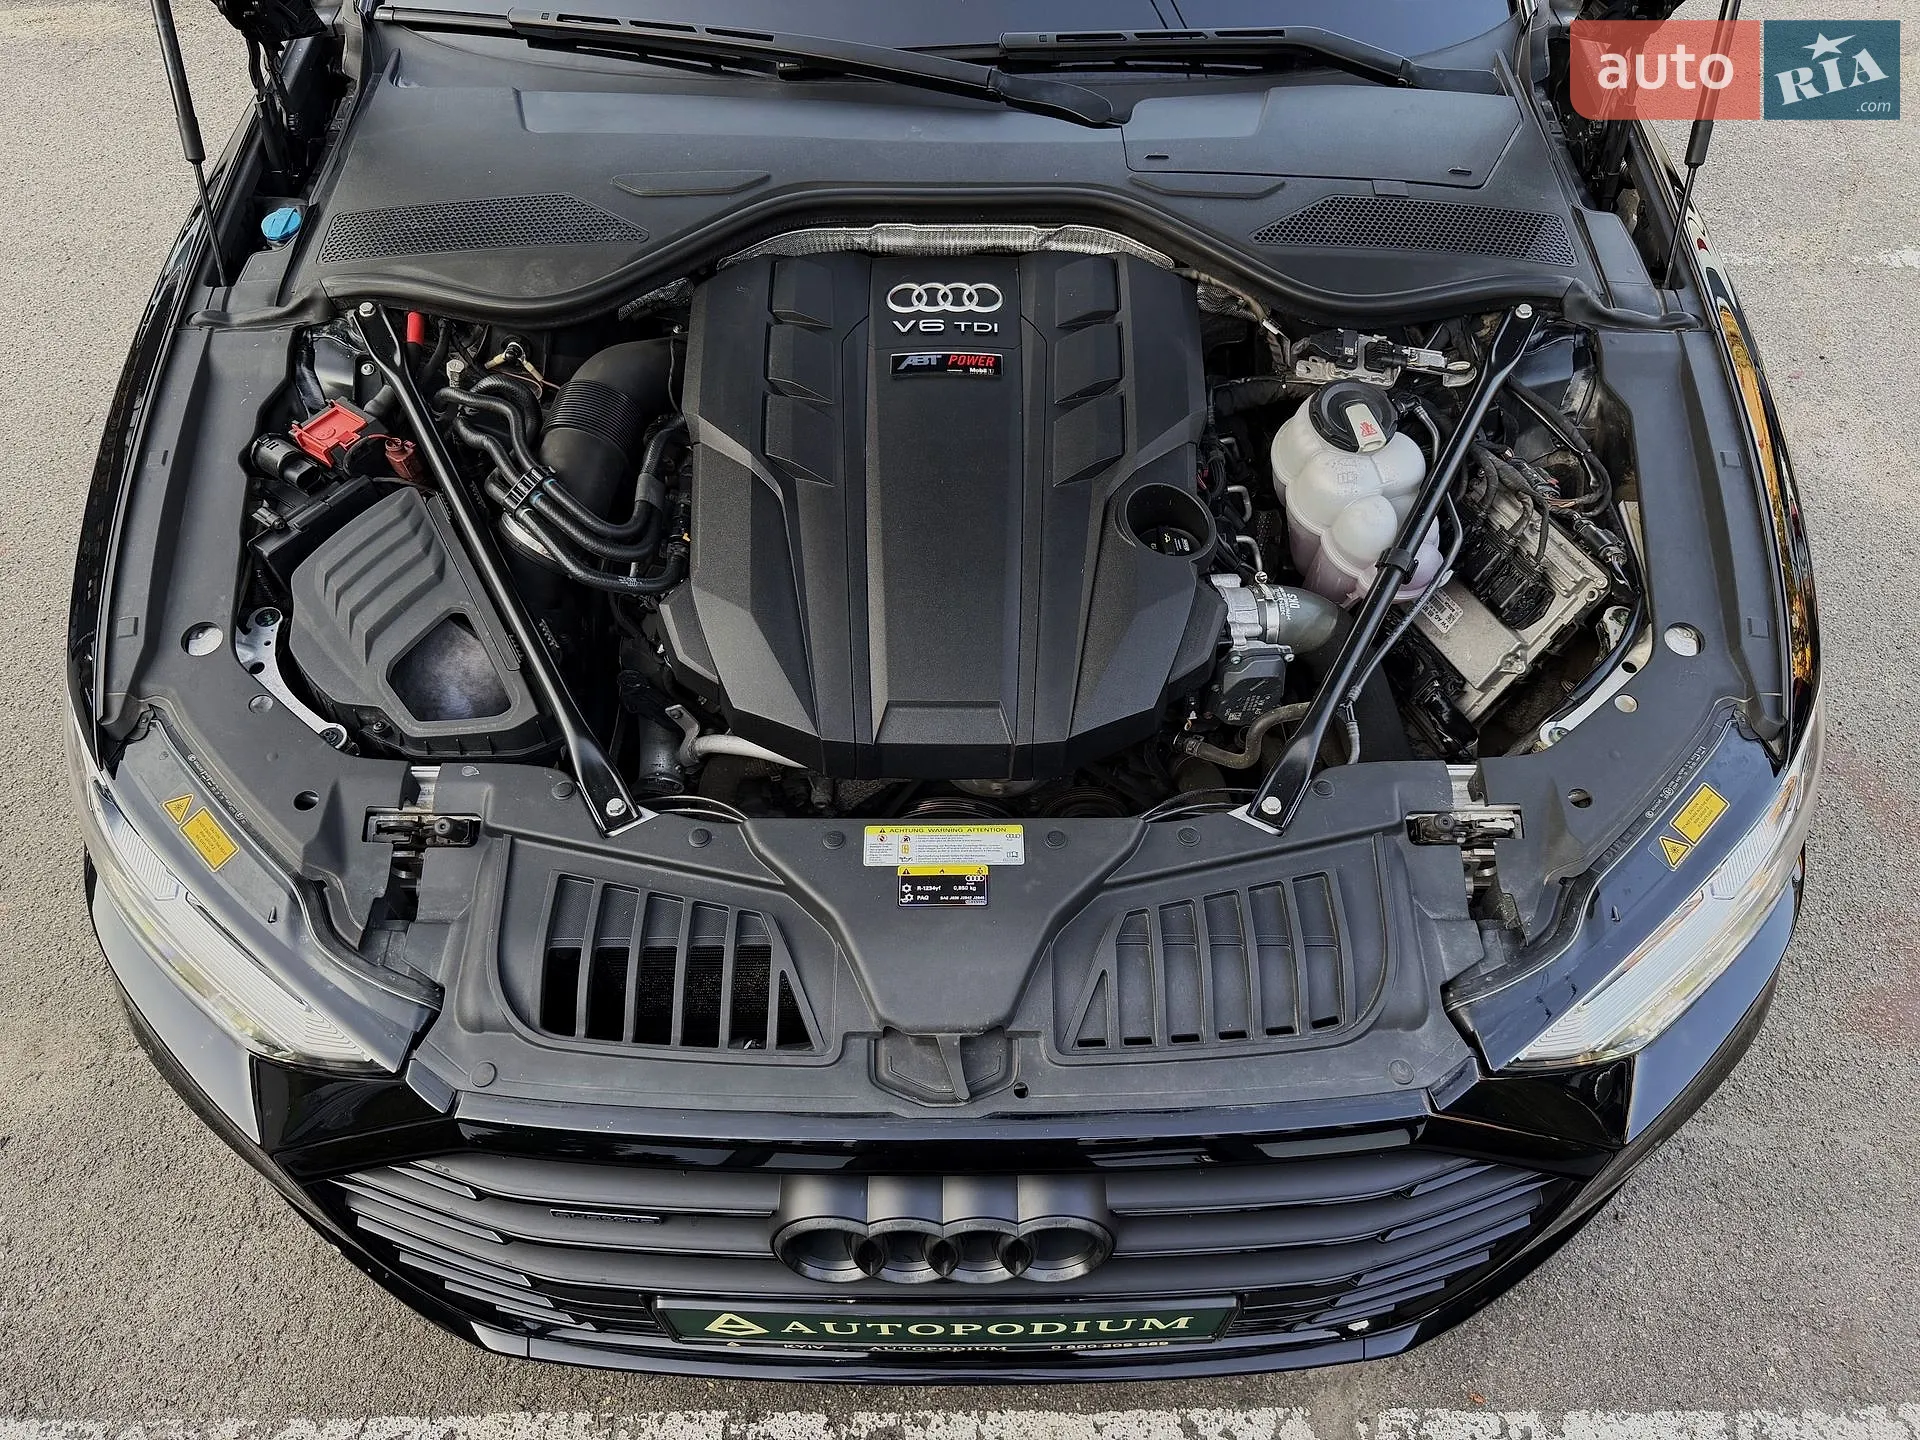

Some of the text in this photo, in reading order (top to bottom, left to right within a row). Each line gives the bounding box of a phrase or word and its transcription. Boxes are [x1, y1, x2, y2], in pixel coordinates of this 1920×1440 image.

[892, 319, 999, 333] V6 TDI
[897, 354, 996, 370] ABT POWER
[781, 1316, 1195, 1336] AUTOPODIUM
